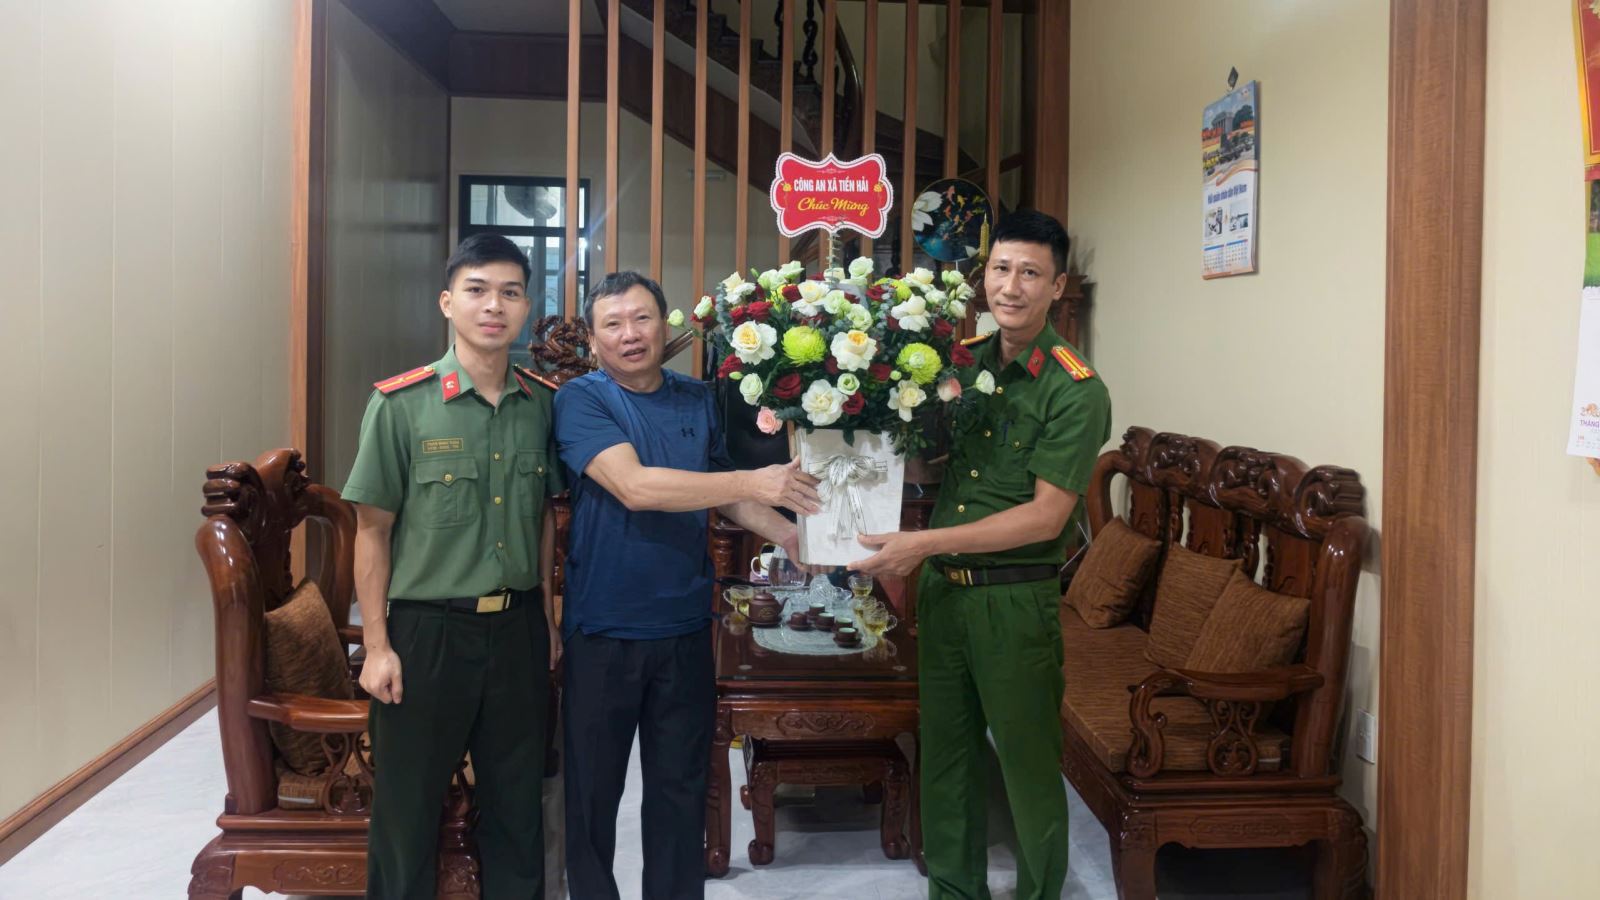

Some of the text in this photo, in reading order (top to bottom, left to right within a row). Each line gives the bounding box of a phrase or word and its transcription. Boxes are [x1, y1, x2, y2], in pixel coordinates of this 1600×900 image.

[793, 177, 815, 192] CÔNG
[815, 180, 826, 192] AN
[827, 177, 838, 192] XÃ
[856, 176, 869, 192] HẢI
[797, 197, 830, 211] Chúc
